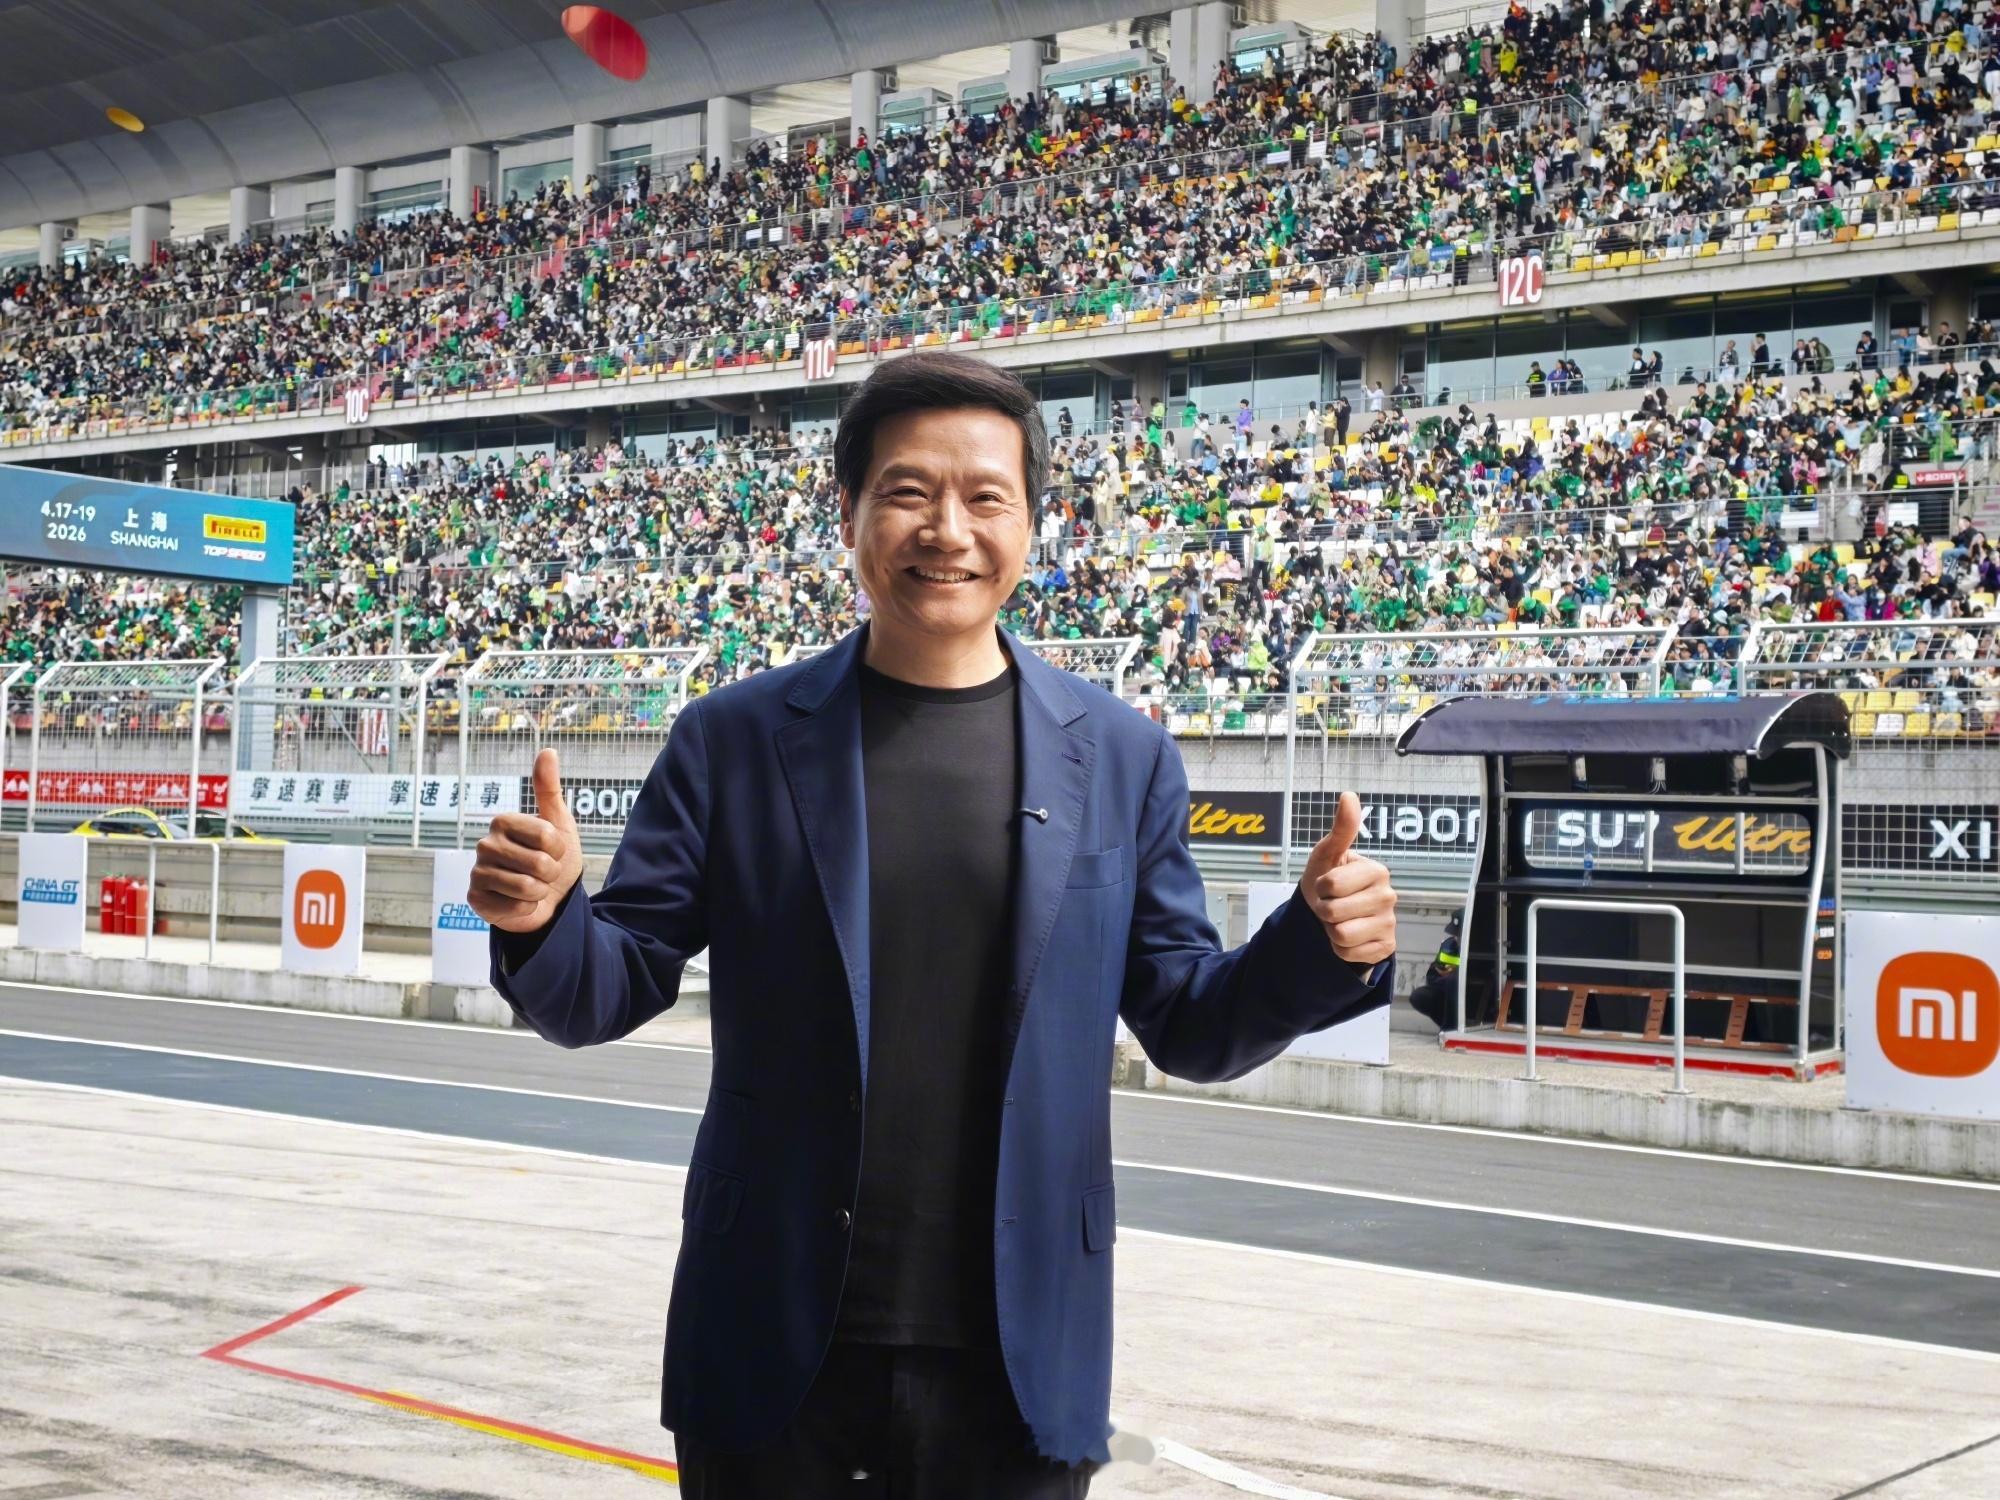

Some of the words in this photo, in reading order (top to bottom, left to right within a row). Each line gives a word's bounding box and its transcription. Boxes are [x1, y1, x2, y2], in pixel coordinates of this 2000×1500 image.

[1500, 255, 1542, 306] 12C
[806, 339, 835, 379] 11C
[345, 388, 368, 423] 10C
[40, 500, 96, 522] 4.17-19
[123, 507, 168, 532] 上海
[47, 522, 86, 542] 2026
[110, 530, 178, 551] SHANGHAI
[1190, 803, 1266, 835] ltra
[24, 878, 58, 891] CHINA
[62, 880, 79, 892] GT
